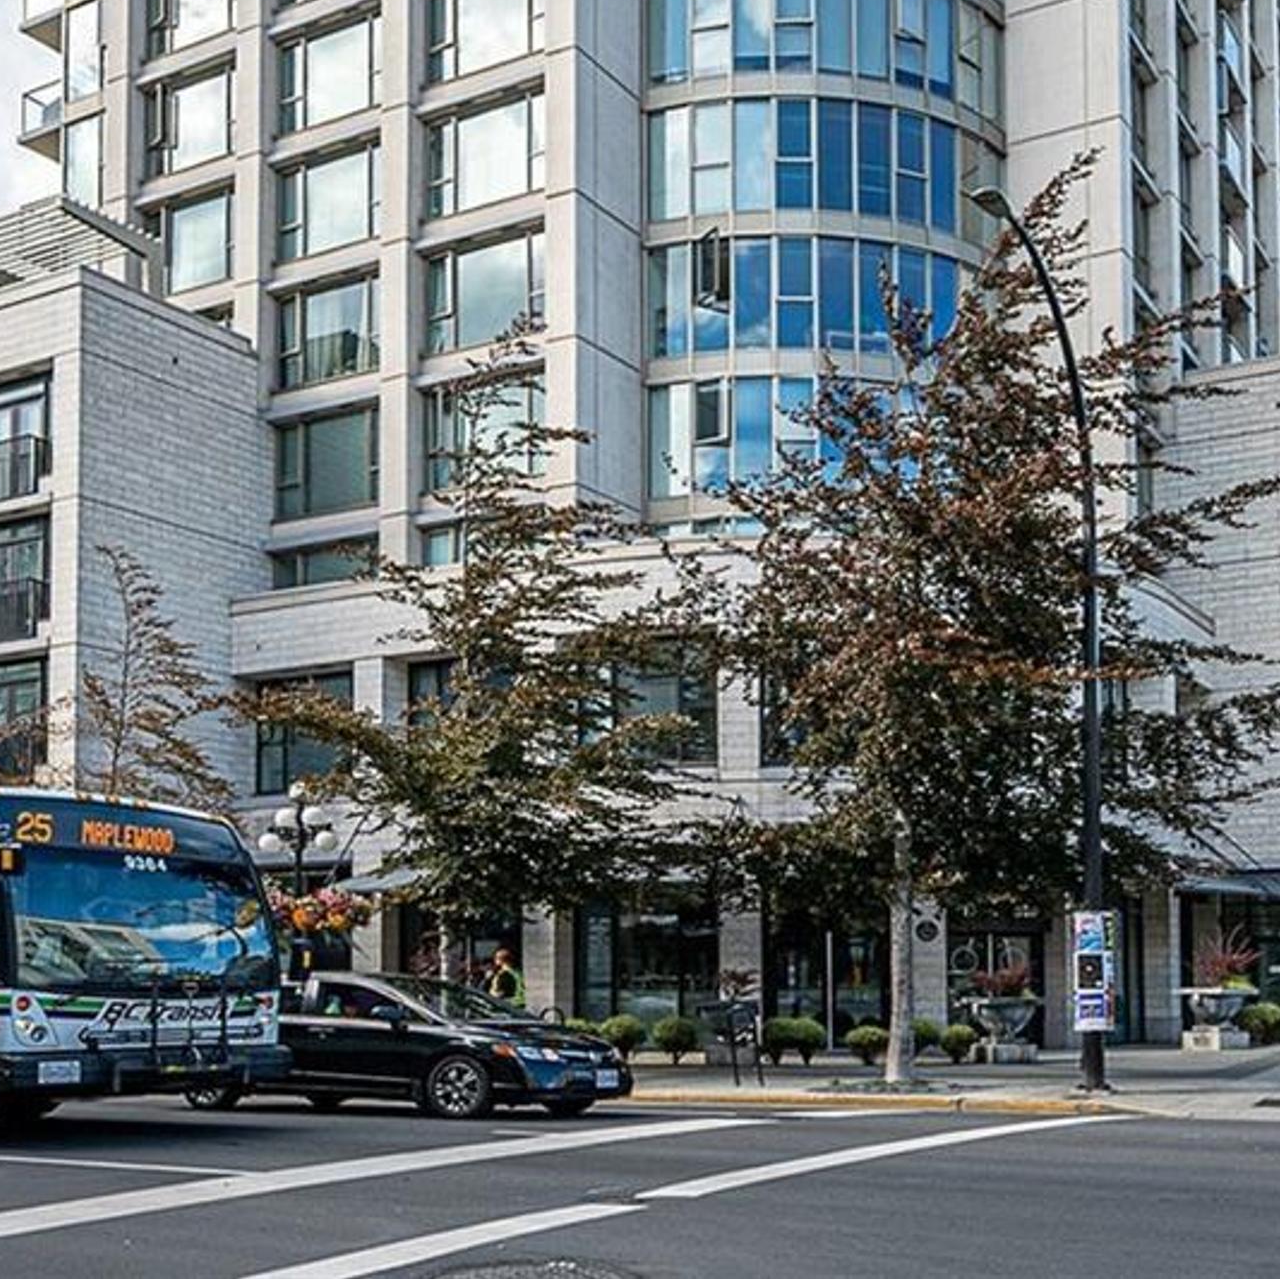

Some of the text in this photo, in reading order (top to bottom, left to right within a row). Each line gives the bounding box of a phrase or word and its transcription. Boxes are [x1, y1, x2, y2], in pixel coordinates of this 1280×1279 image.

[16, 811, 174, 855] 25 MAPLEWOOD
[103, 1001, 227, 1021] BCTransi
